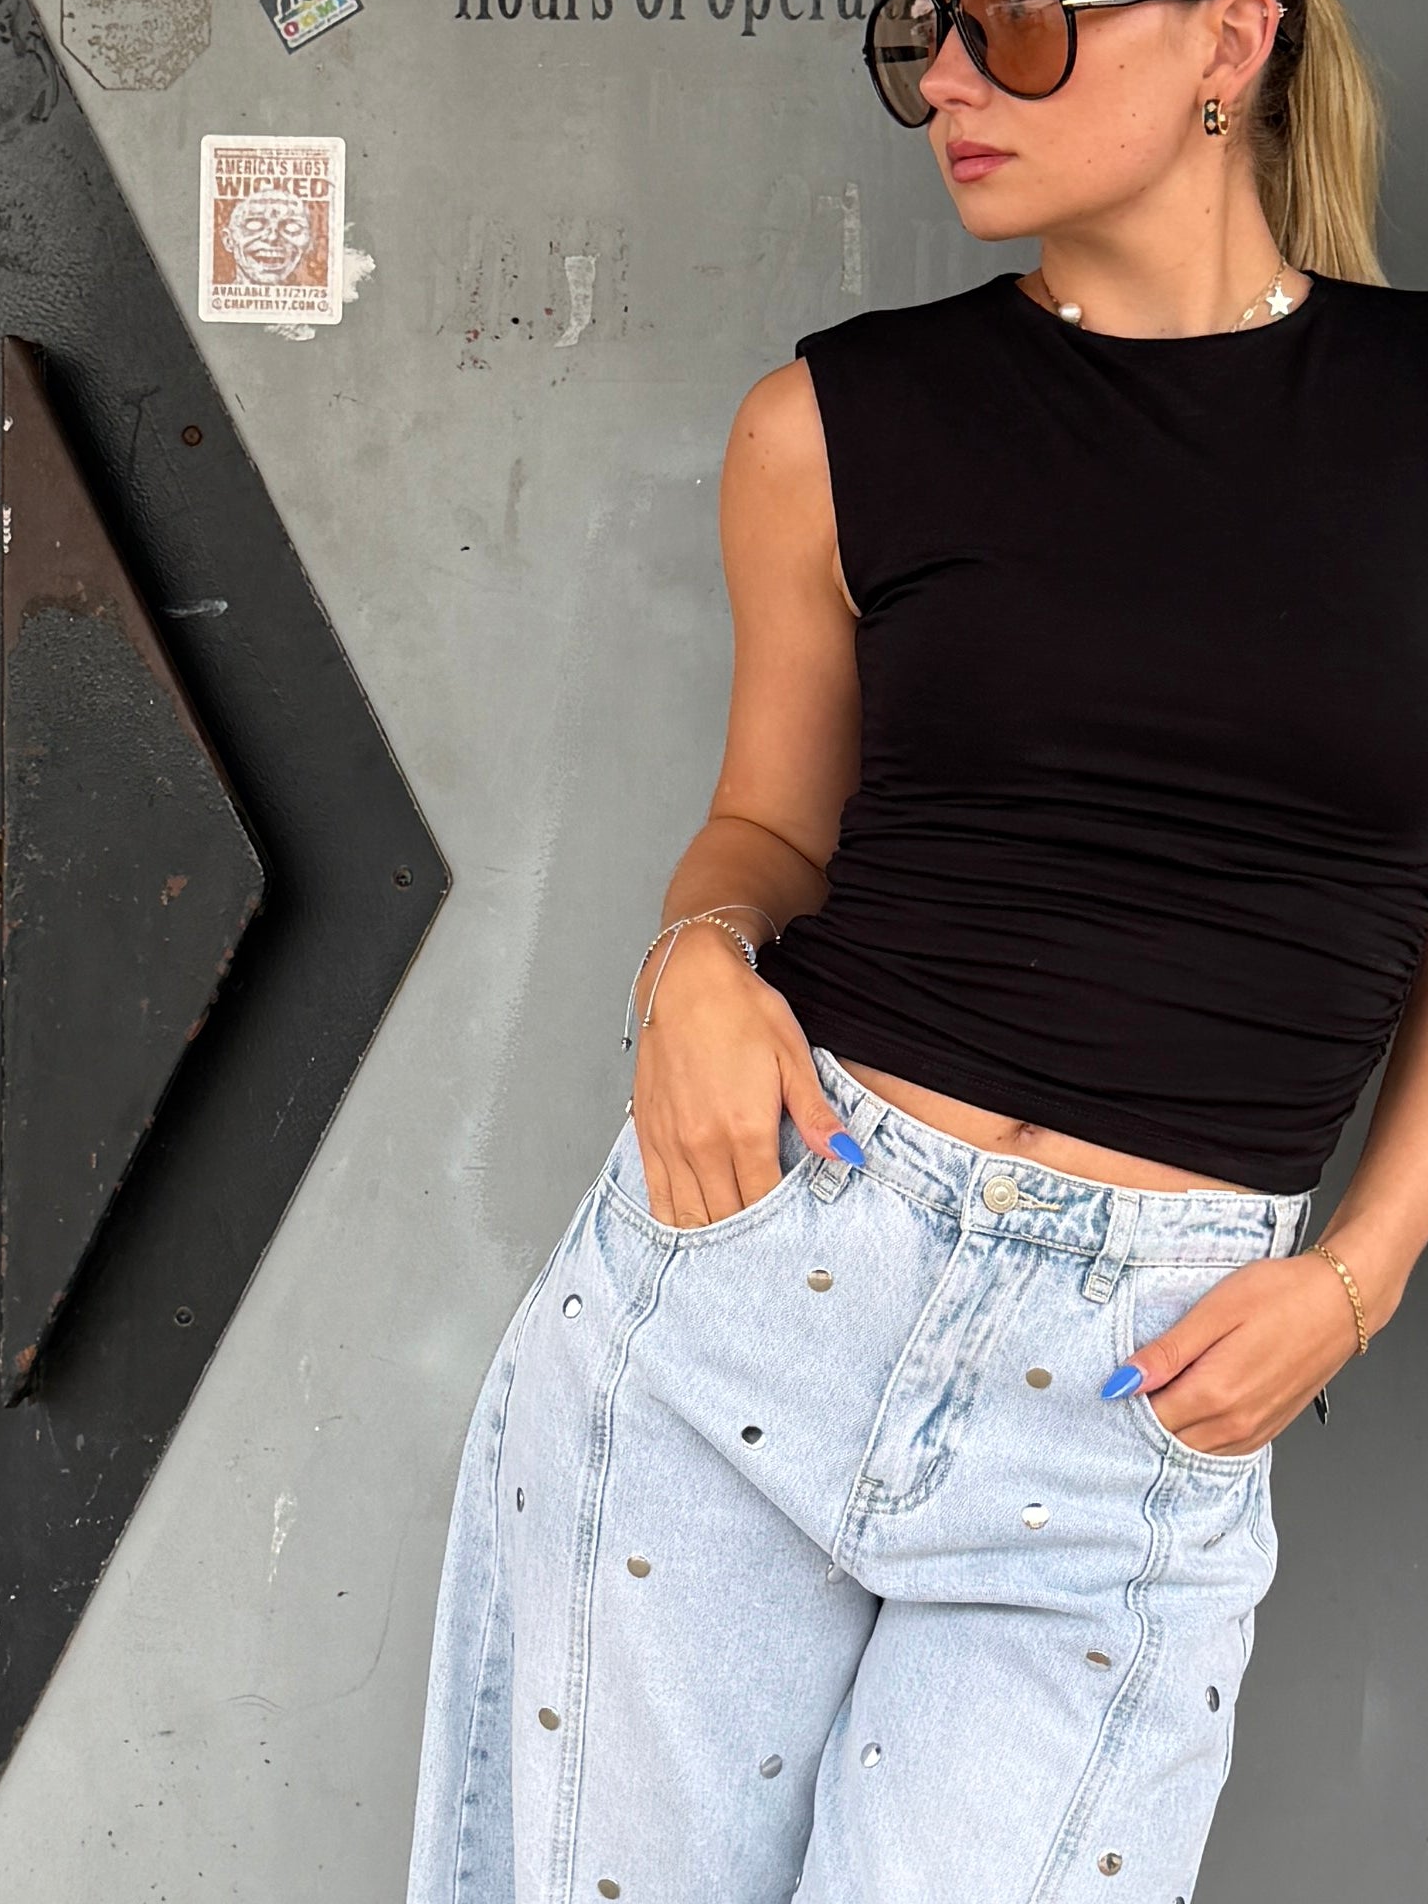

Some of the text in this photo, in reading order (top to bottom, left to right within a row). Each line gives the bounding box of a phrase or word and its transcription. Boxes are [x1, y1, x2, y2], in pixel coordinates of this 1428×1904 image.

[215, 157, 330, 176] AMERICA'S MOST
[215, 176, 330, 198] WICKED
[212, 286, 271, 297] AVAILABLE
